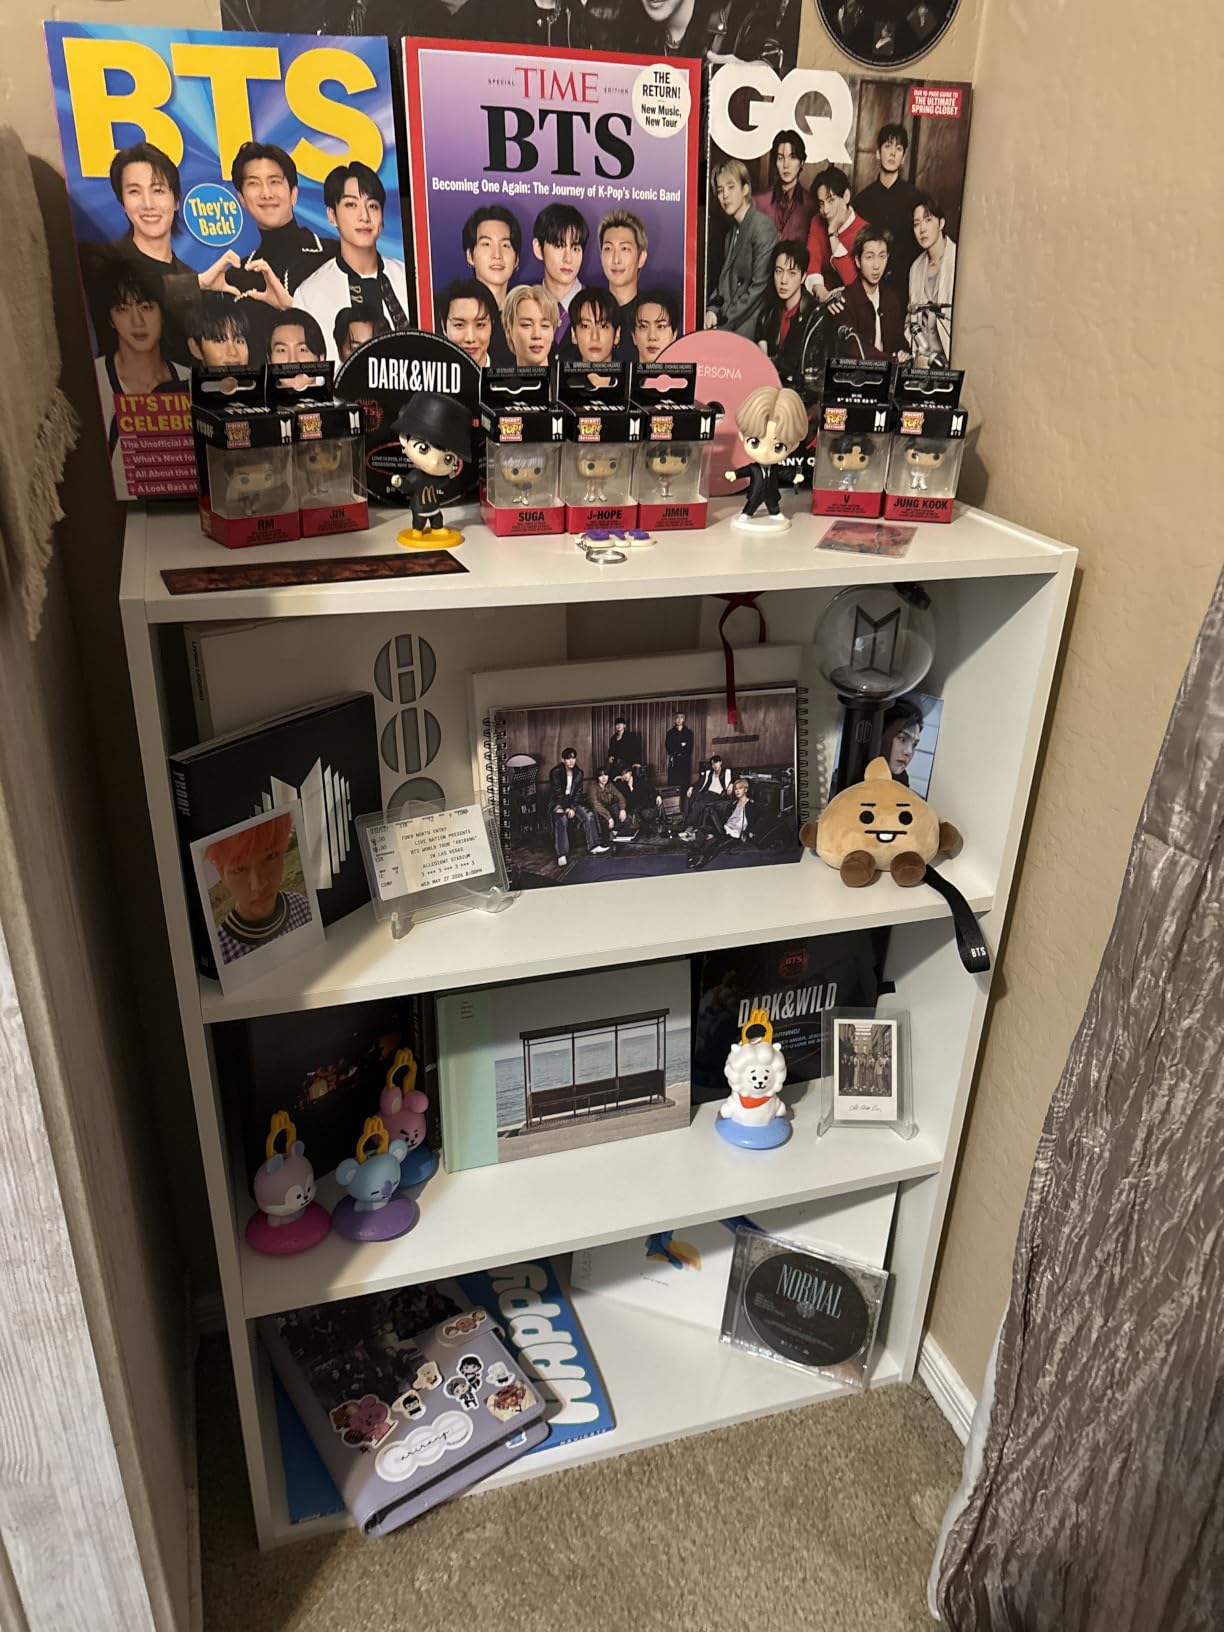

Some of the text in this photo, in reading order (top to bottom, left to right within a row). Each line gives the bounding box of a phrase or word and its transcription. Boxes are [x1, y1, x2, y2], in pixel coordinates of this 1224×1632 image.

[654, 71, 671, 84] THE
[488, 67, 629, 104] SPECIAL TIME EDITION
[642, 84, 681, 99] RETURN!
[915, 96, 956, 107] THE ULTIMATE
[62, 37, 383, 184] BTS
[641, 104, 682, 118] New Music,
[709, 63, 852, 164] GQ
[911, 104, 958, 115] SPRING CLOSET
[645, 116, 678, 128] New Tour
[480, 105, 635, 180] BTS
[432, 177, 681, 201] Becoming One Again: The Journey of K-Pop's Iconic Band
[188, 197, 237, 220] They're
[199, 216, 236, 236] Back!
[368, 357, 461, 394] DARK&WILD
[697, 365, 742, 380] ERSONA
[120, 395, 192, 412] IT'S TIM
[120, 415, 193, 432] CELEBR
[122, 440, 139, 449] The
[141, 440, 181, 448] Unofficial
[132, 455, 162, 463] What's
[164, 454, 183, 462] Next
[807, 456, 815, 467] Q
[136, 470, 147, 478] All
[149, 469, 174, 478] About
[176, 469, 189, 477] the
[146, 484, 165, 492] Look
[168, 483, 187, 491] Back
[844, 495, 850, 503] V
[894, 500, 948, 510] JUNG KOOK
[330, 507, 345, 519] JIN
[518, 511, 545, 522] SUGA
[587, 510, 622, 520] J-HOPE
[663, 508, 689, 517] JIMIN
[258, 519, 275, 529] RM
[448, 829, 471, 838] PRESENTS
[423, 854, 471, 868] ALLEGIANT STADIUM
[971, 947, 986, 957] BTS
[776, 1264, 842, 1320] NORMAL
[560, 1428, 607, 1446] NAVIGATE
